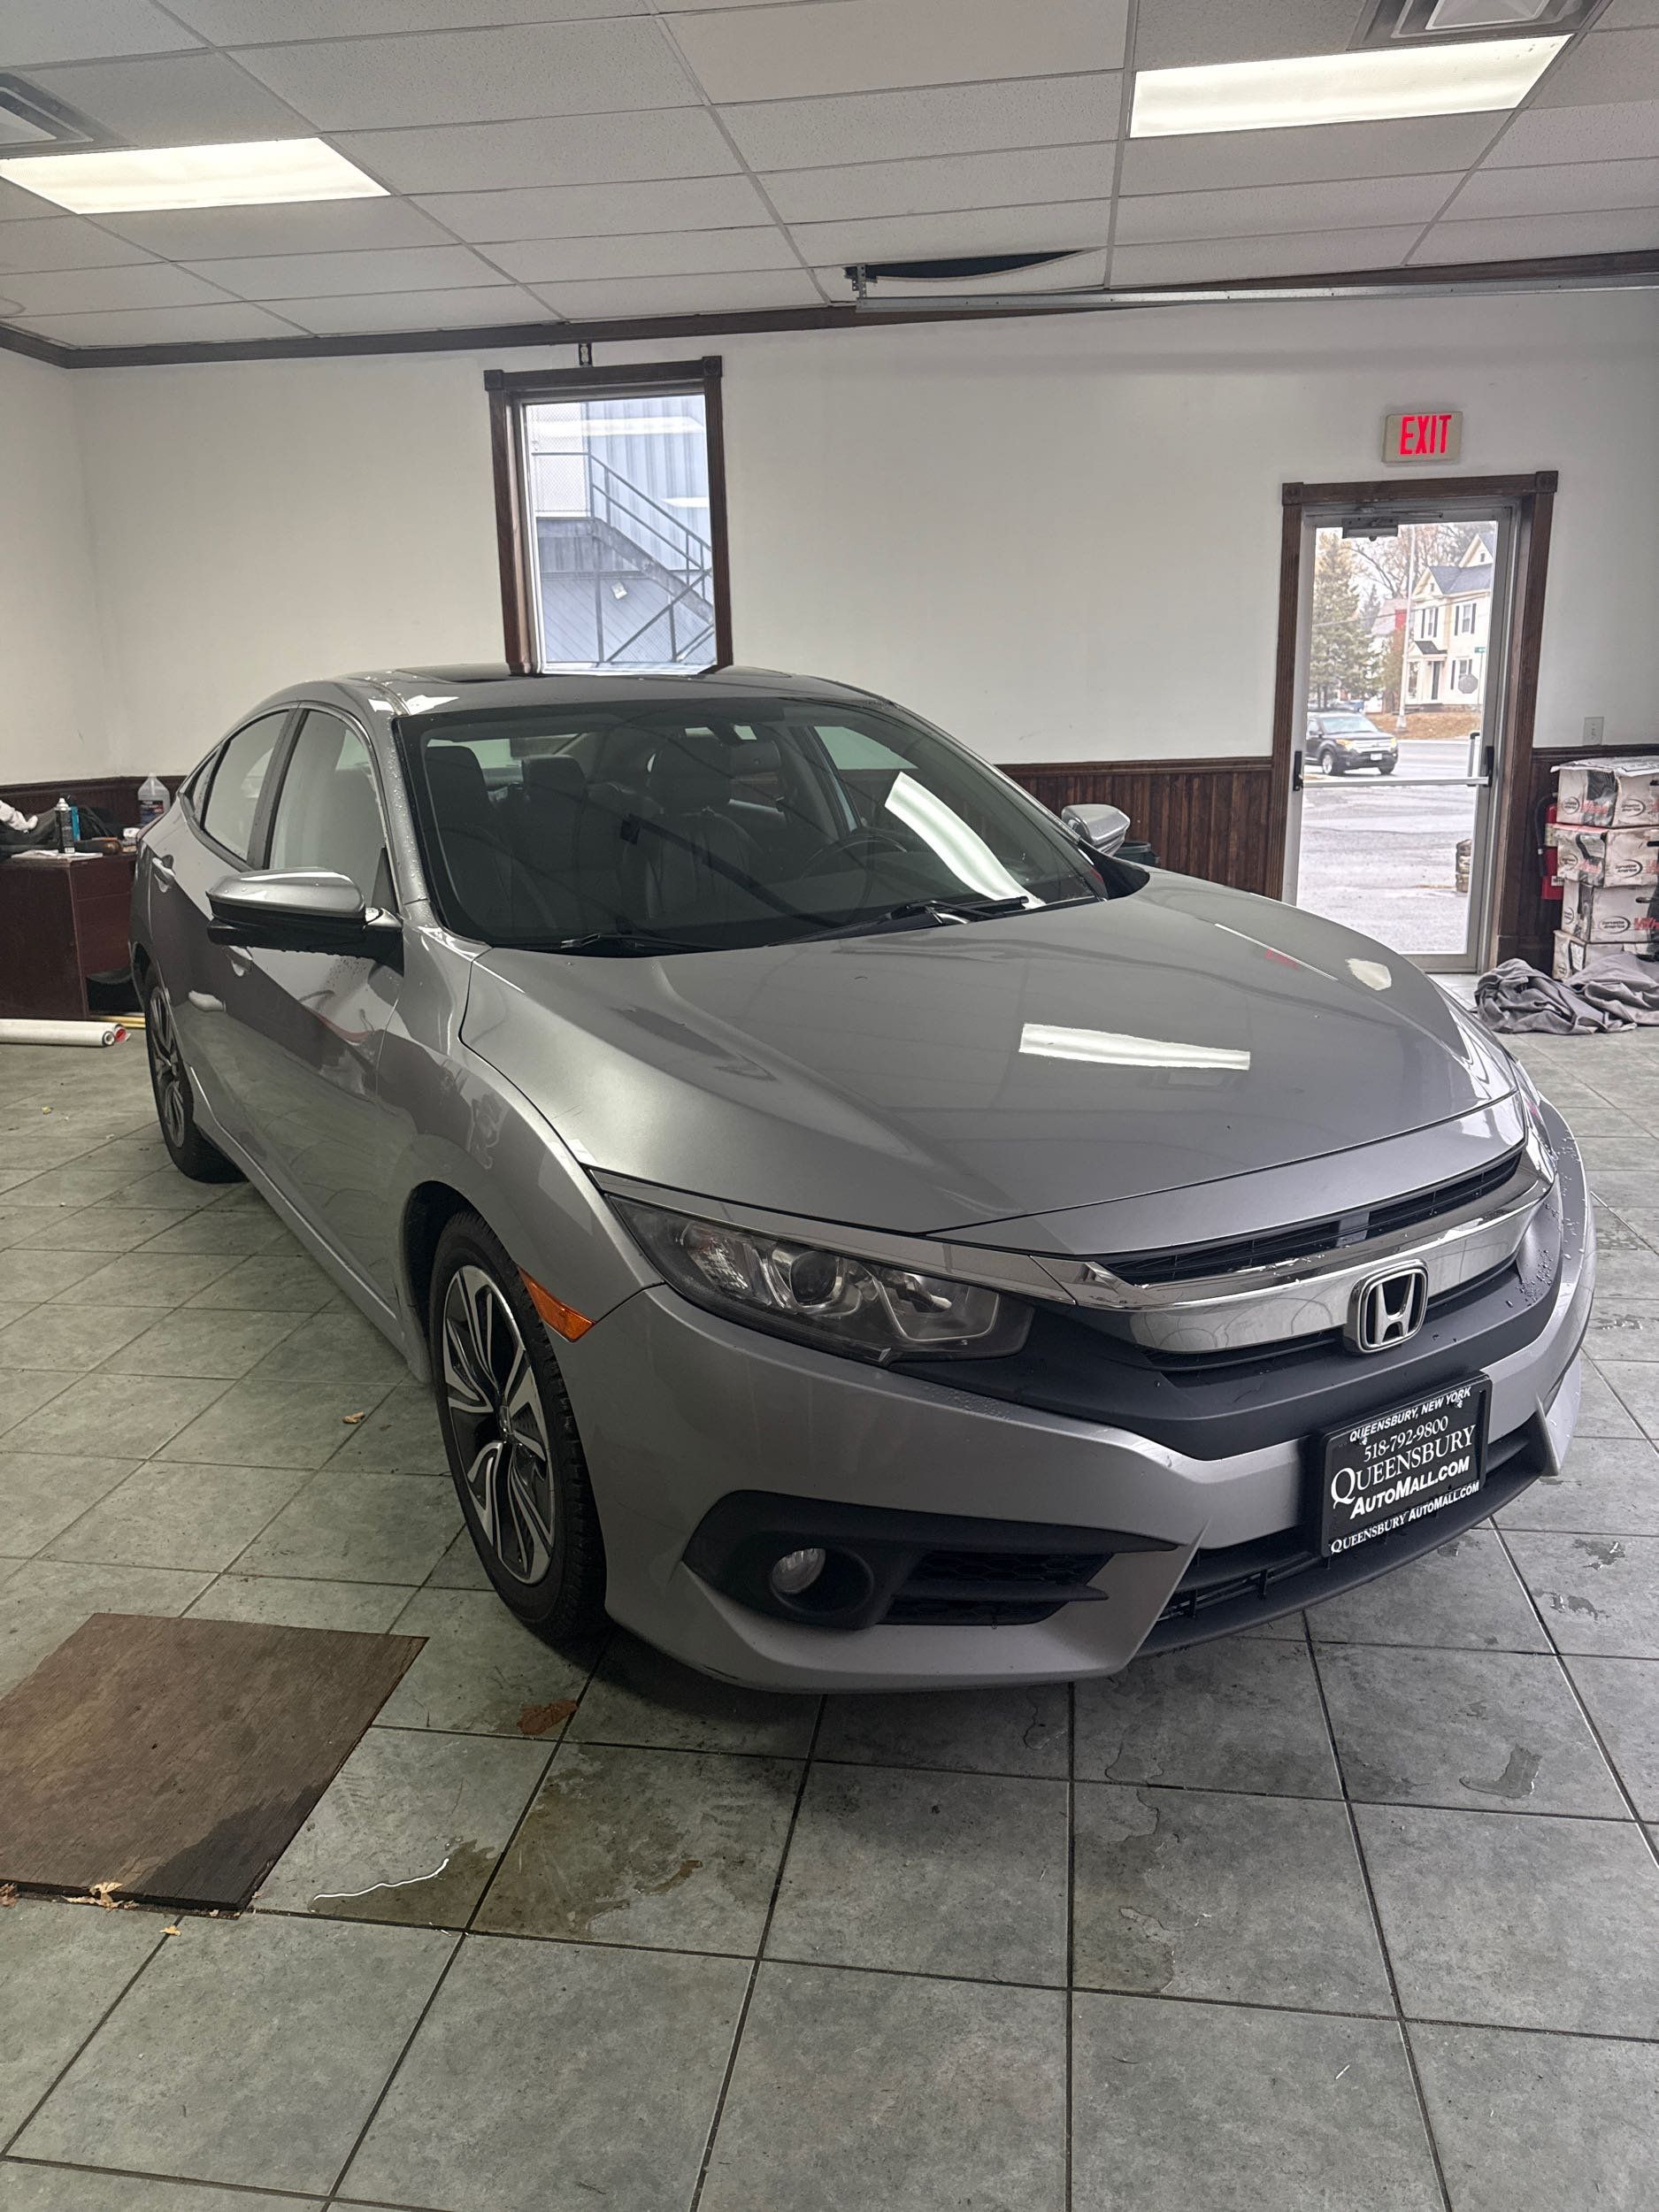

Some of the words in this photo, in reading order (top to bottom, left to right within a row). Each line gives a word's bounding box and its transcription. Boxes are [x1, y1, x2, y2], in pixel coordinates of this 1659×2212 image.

[1399, 414, 1452, 455] EXIT
[1349, 1407, 1419, 1442] QUEENSBURY,
[1421, 1397, 1445, 1415] NEW
[1446, 1386, 1471, 1405] YORK
[1363, 1416, 1449, 1463] 518-792-9800
[1331, 1425, 1477, 1509] QUEENSBURY
[1331, 1510, 1409, 1555] QUEENSBURY
